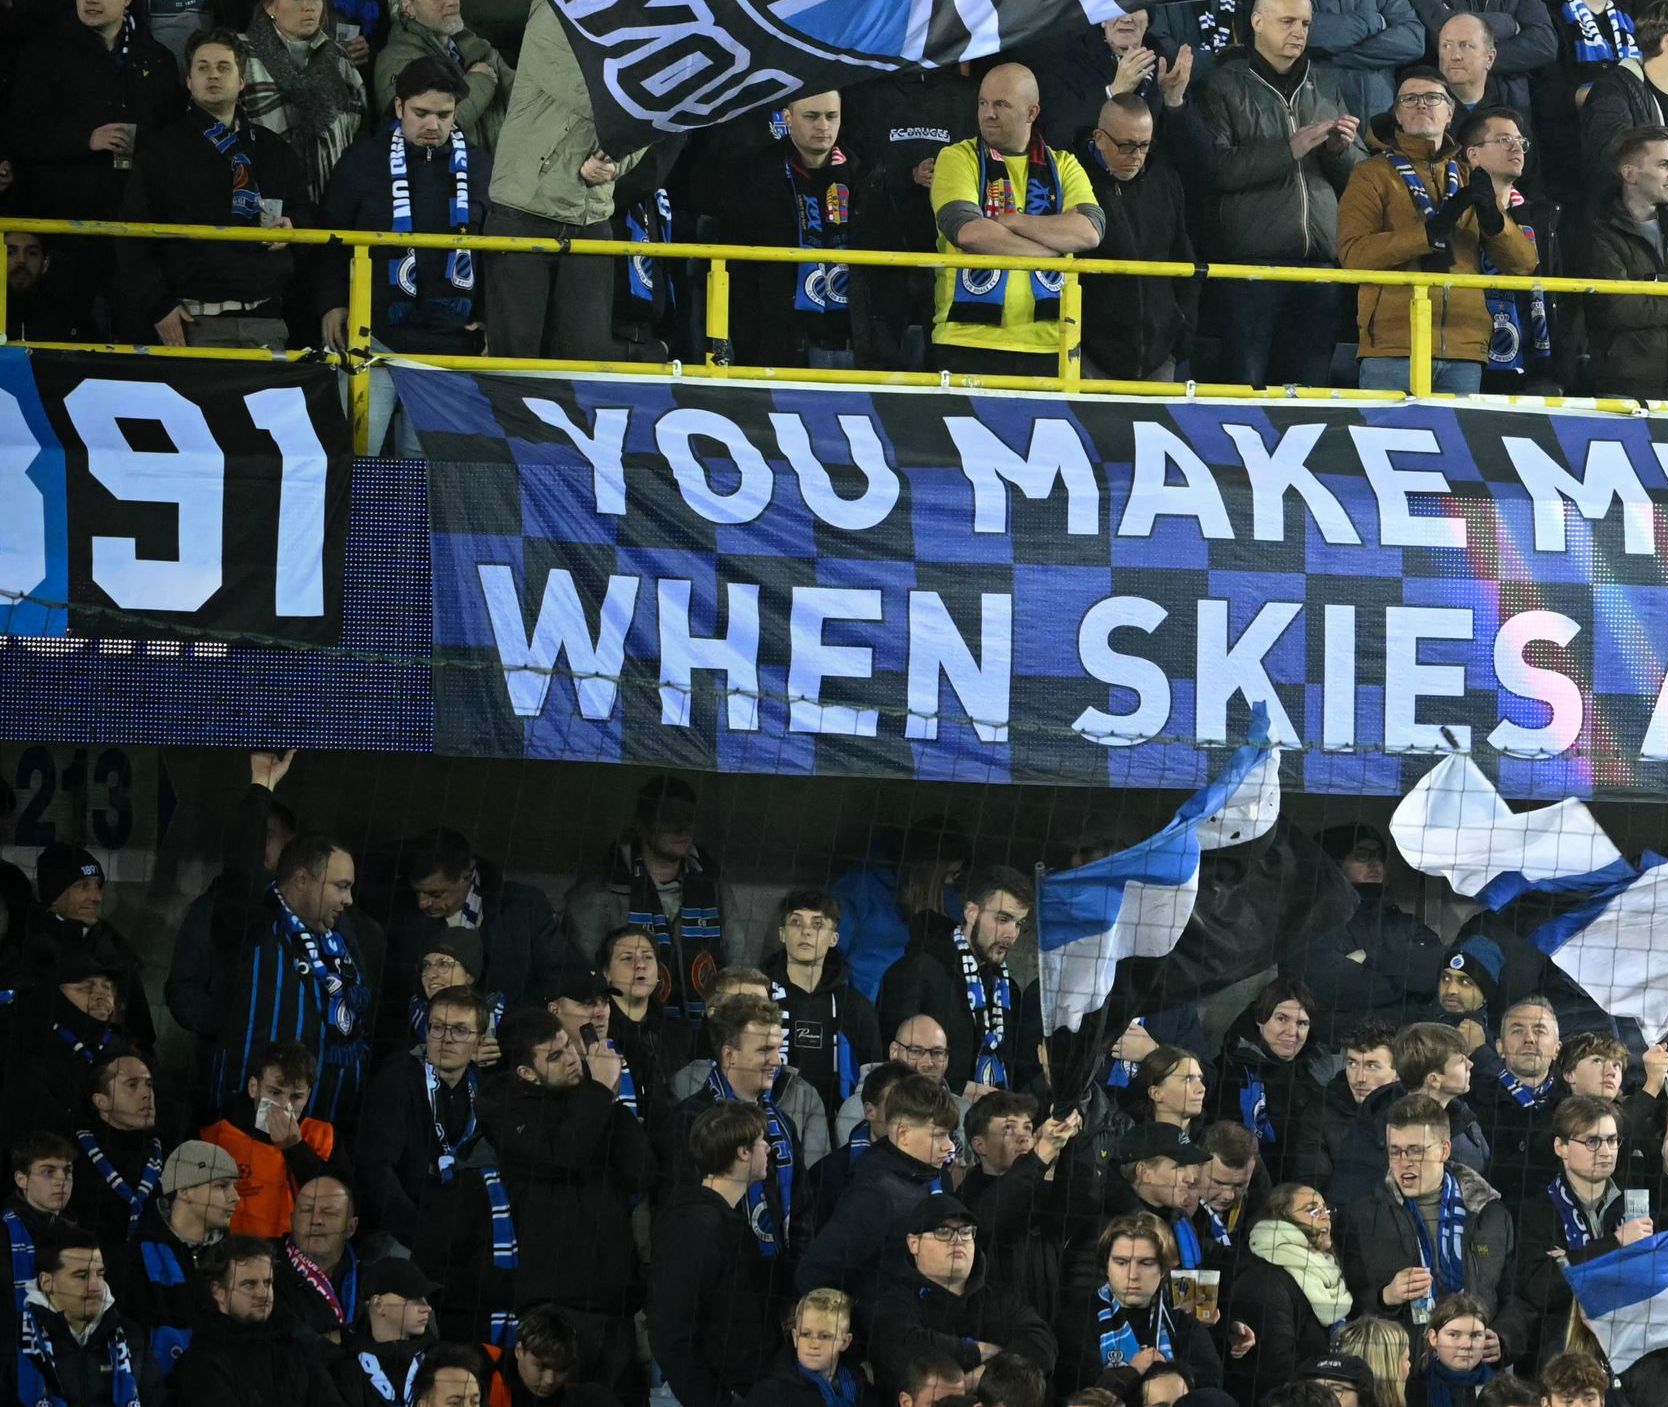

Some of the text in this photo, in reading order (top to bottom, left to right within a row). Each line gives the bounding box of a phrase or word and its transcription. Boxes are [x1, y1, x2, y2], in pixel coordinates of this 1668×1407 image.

[522, 397, 901, 530] YOU
[944, 416, 1466, 547] MAKE
[478, 565, 1011, 742] WHEN
[1073, 596, 1583, 759] SKIES
[15, 746, 133, 849] 213
